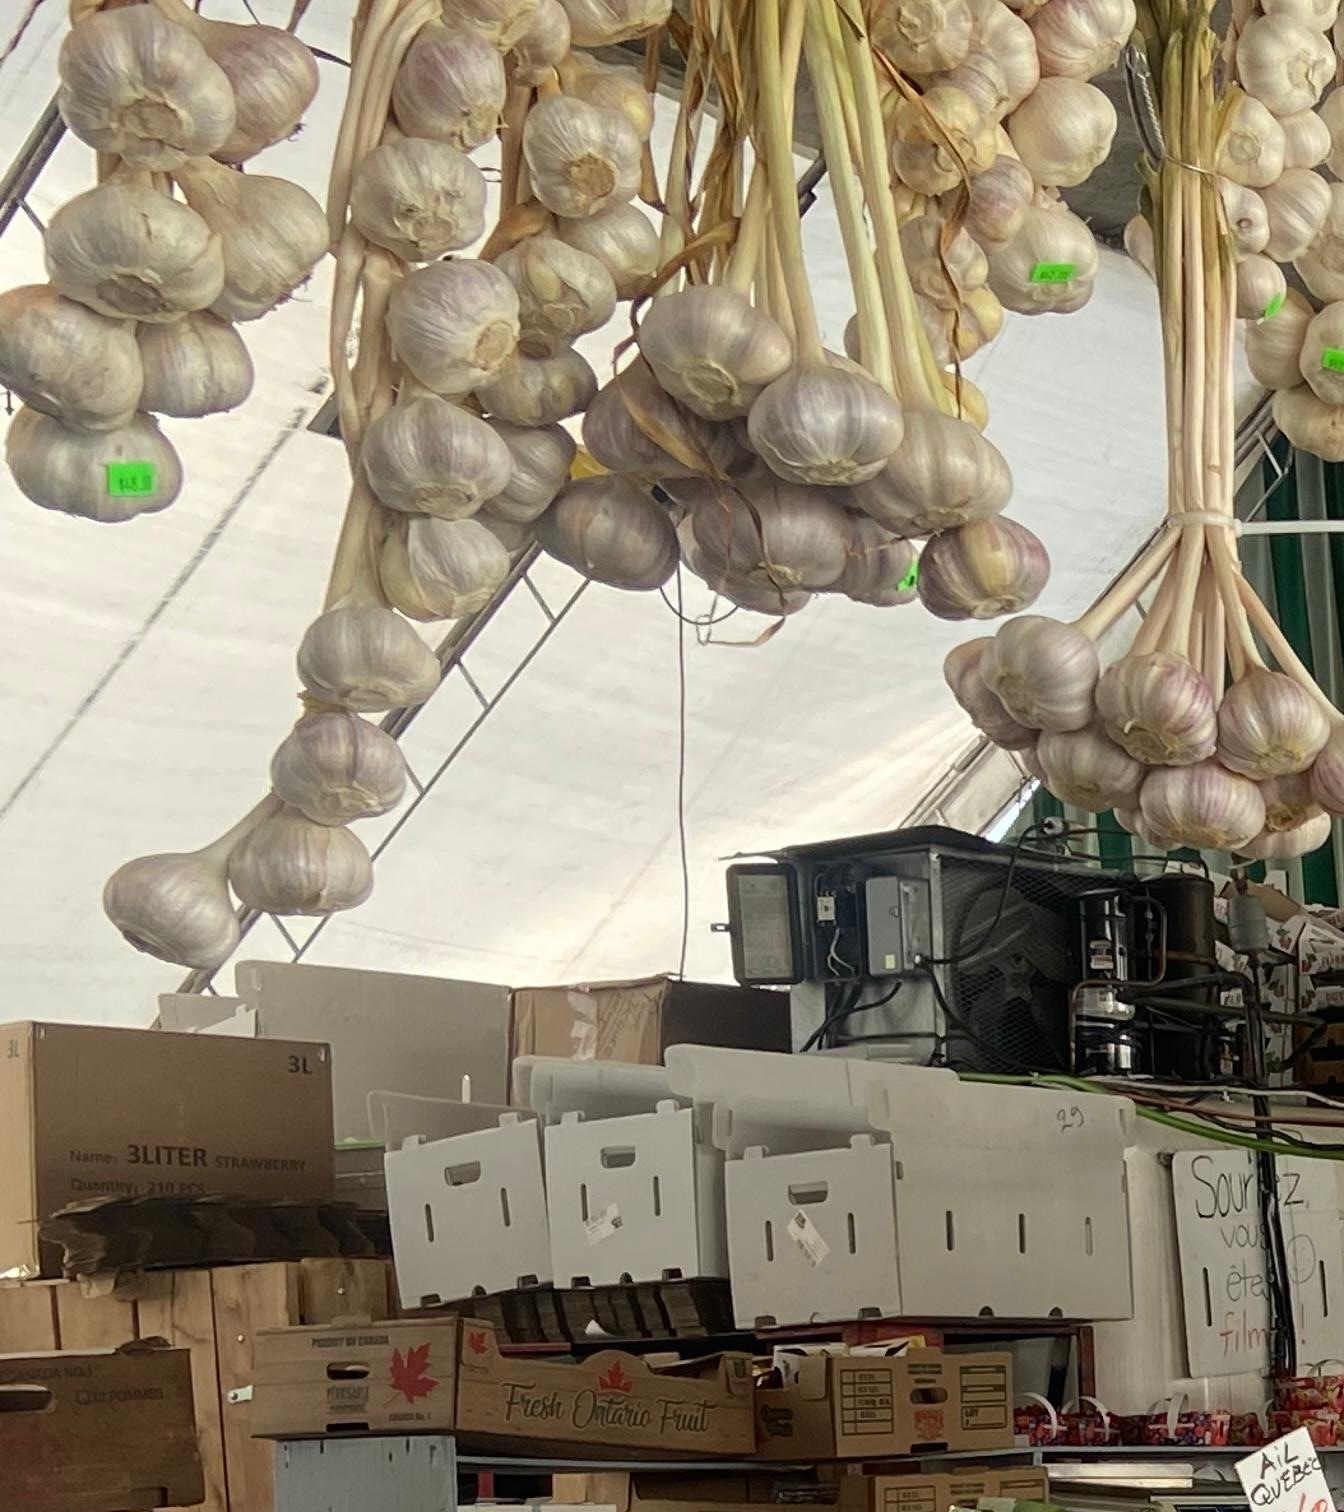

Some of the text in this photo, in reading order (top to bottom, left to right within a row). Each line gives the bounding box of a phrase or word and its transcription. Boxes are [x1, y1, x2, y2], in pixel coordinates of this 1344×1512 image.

[287, 1055, 313, 1075] 3L
[127, 1144, 208, 1168] 3LITER
[214, 1155, 307, 1172] STRAWBERRY
[503, 1382, 562, 1423] Fresh
[572, 1388, 652, 1429] Ontario
[656, 1398, 718, 1434] Fruit
